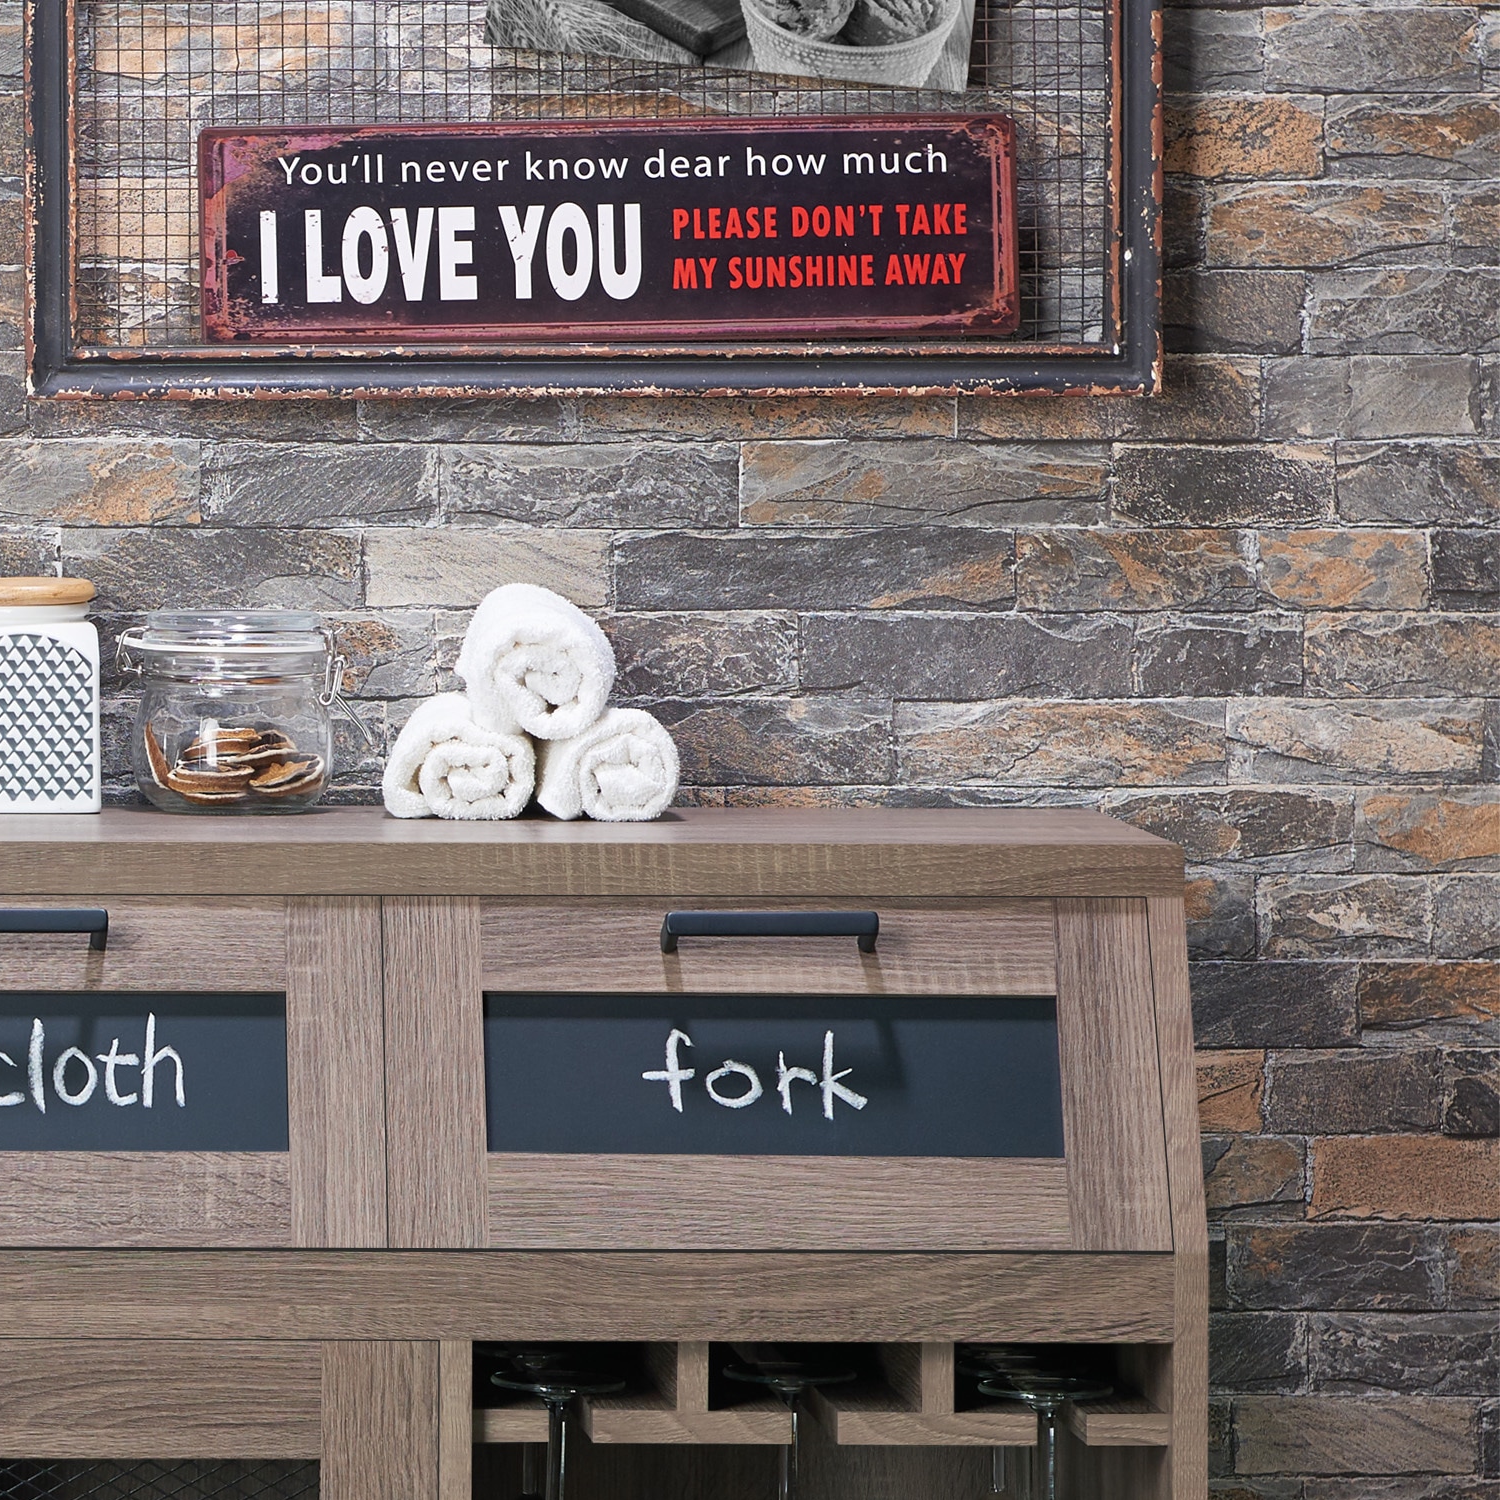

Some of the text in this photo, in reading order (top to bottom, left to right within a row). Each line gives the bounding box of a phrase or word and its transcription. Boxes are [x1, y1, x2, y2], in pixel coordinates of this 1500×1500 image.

[277, 143, 947, 185] You'll never know dear how much
[673, 203, 968, 240] PLEASE DON'T TAKE
[259, 202, 642, 305] I LOVE YOU
[672, 252, 967, 290] MY SUNSHINE AWAY
[641, 1028, 869, 1121] fork
